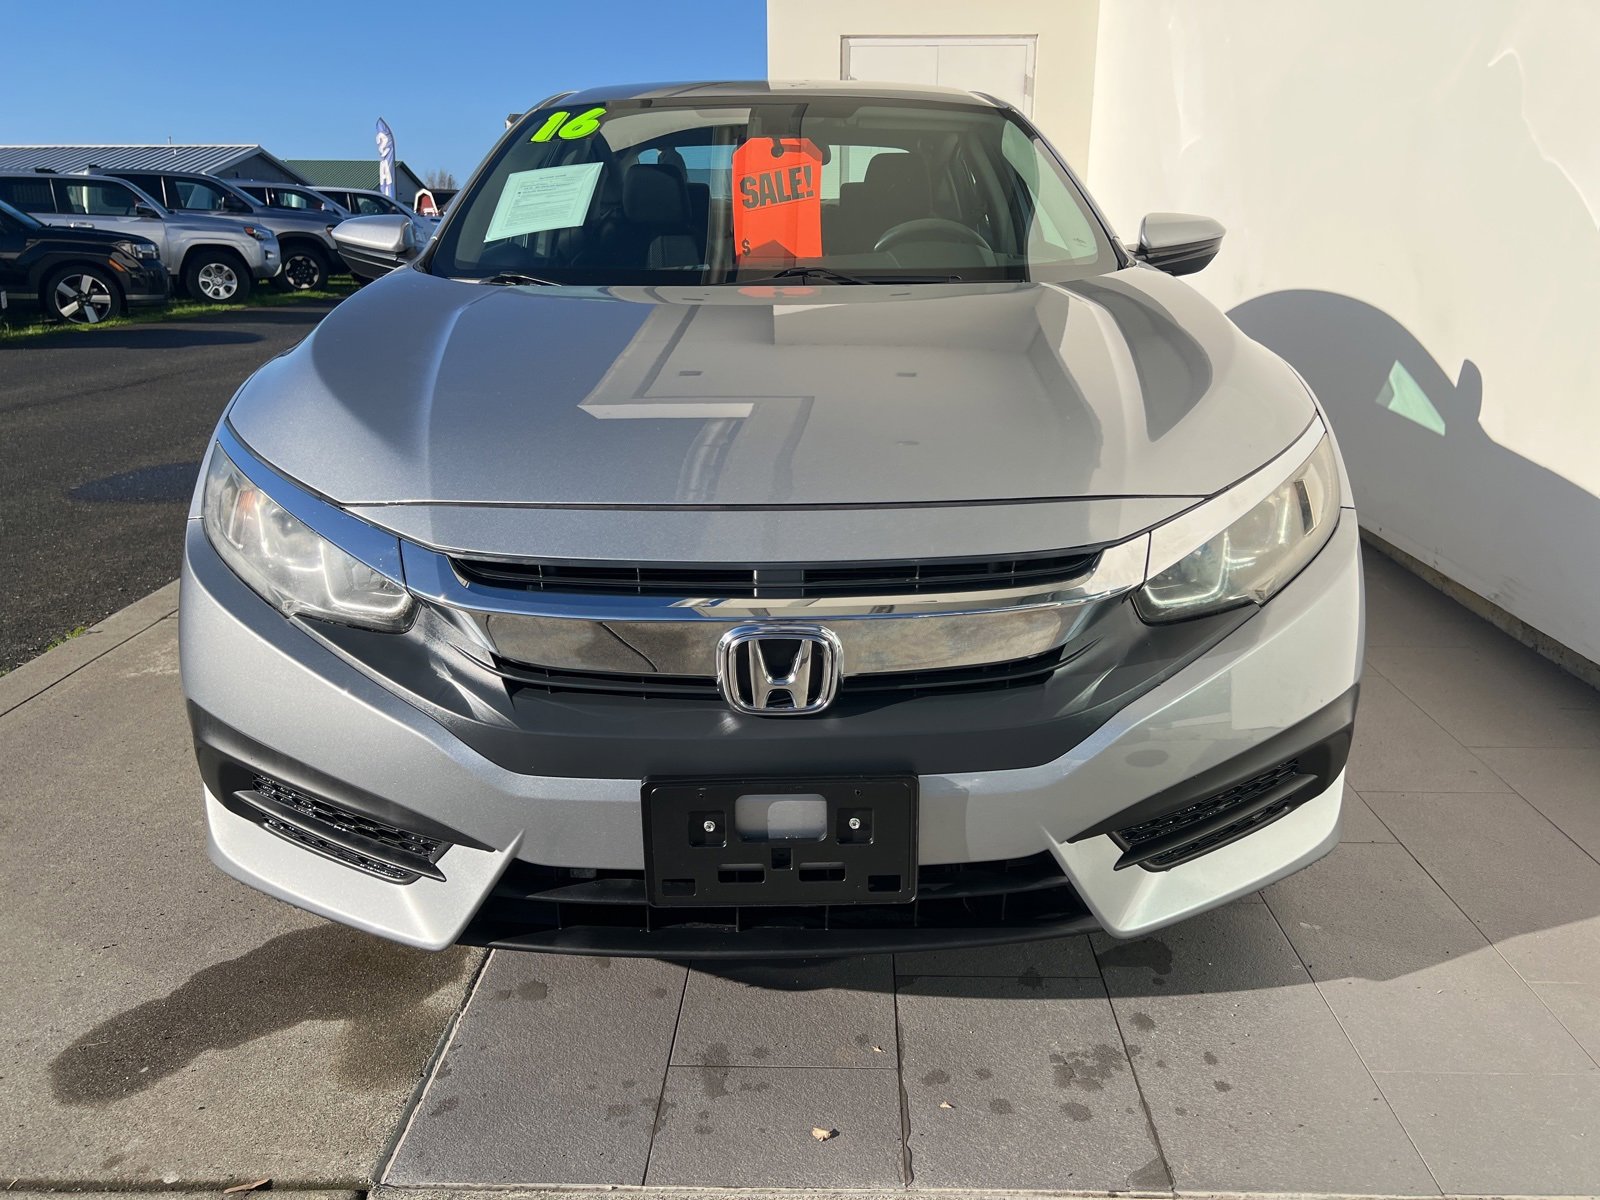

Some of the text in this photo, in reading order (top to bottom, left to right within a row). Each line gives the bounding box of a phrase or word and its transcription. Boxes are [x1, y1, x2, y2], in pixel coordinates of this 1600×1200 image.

[530, 107, 607, 142] 16
[740, 165, 814, 208] SALE!
[741, 237, 751, 256] $
